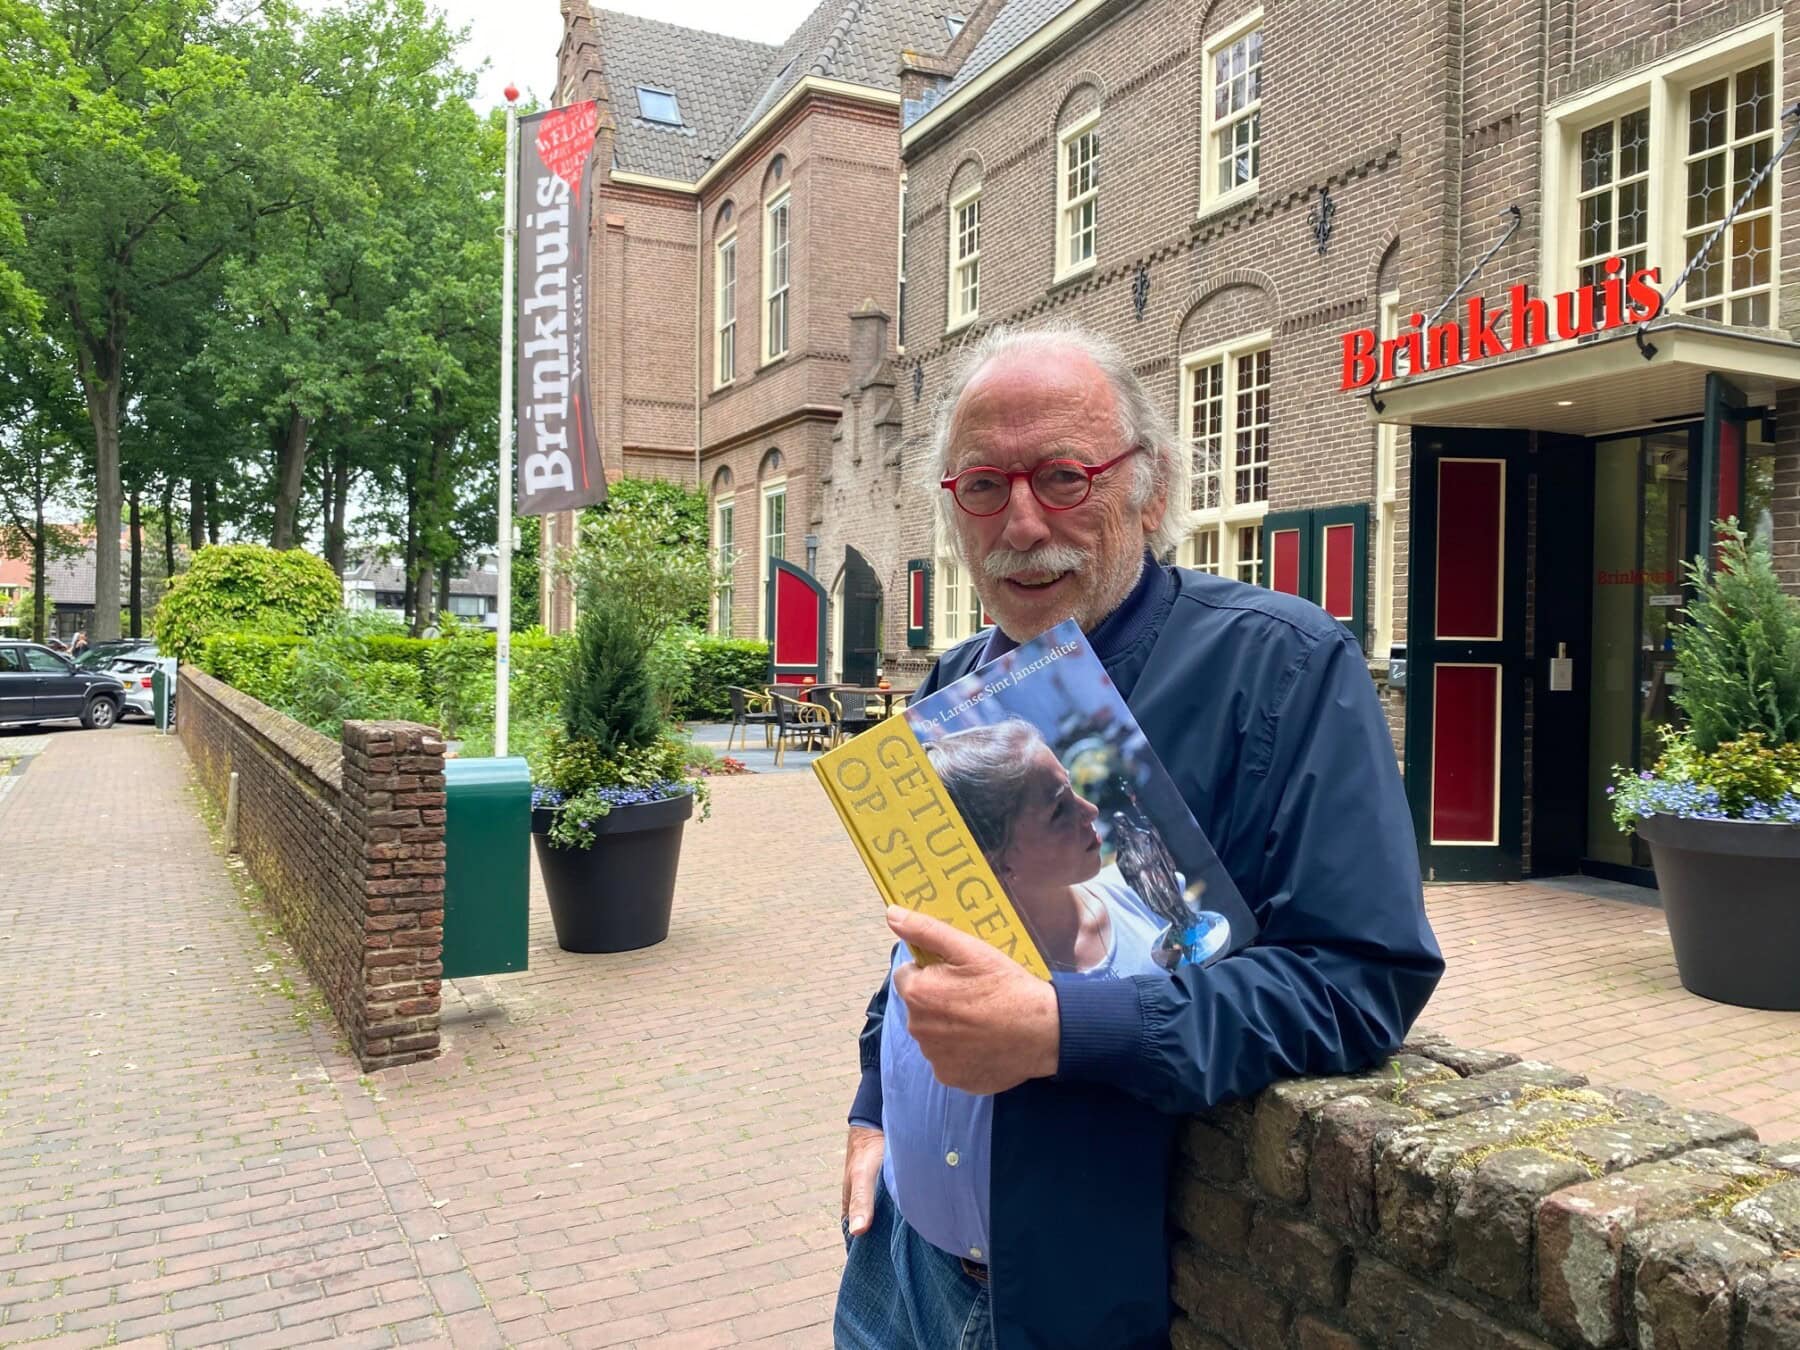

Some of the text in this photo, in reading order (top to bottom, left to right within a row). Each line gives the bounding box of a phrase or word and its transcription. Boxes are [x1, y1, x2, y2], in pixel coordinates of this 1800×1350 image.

[524, 173, 574, 495] Brinkhuis
[1338, 256, 1662, 392] Brinkhuis
[920, 638, 1079, 733] De Larense Sint Janstraditie
[836, 757, 955, 927] OP STR
[876, 735, 1043, 978] GETUIGEN
